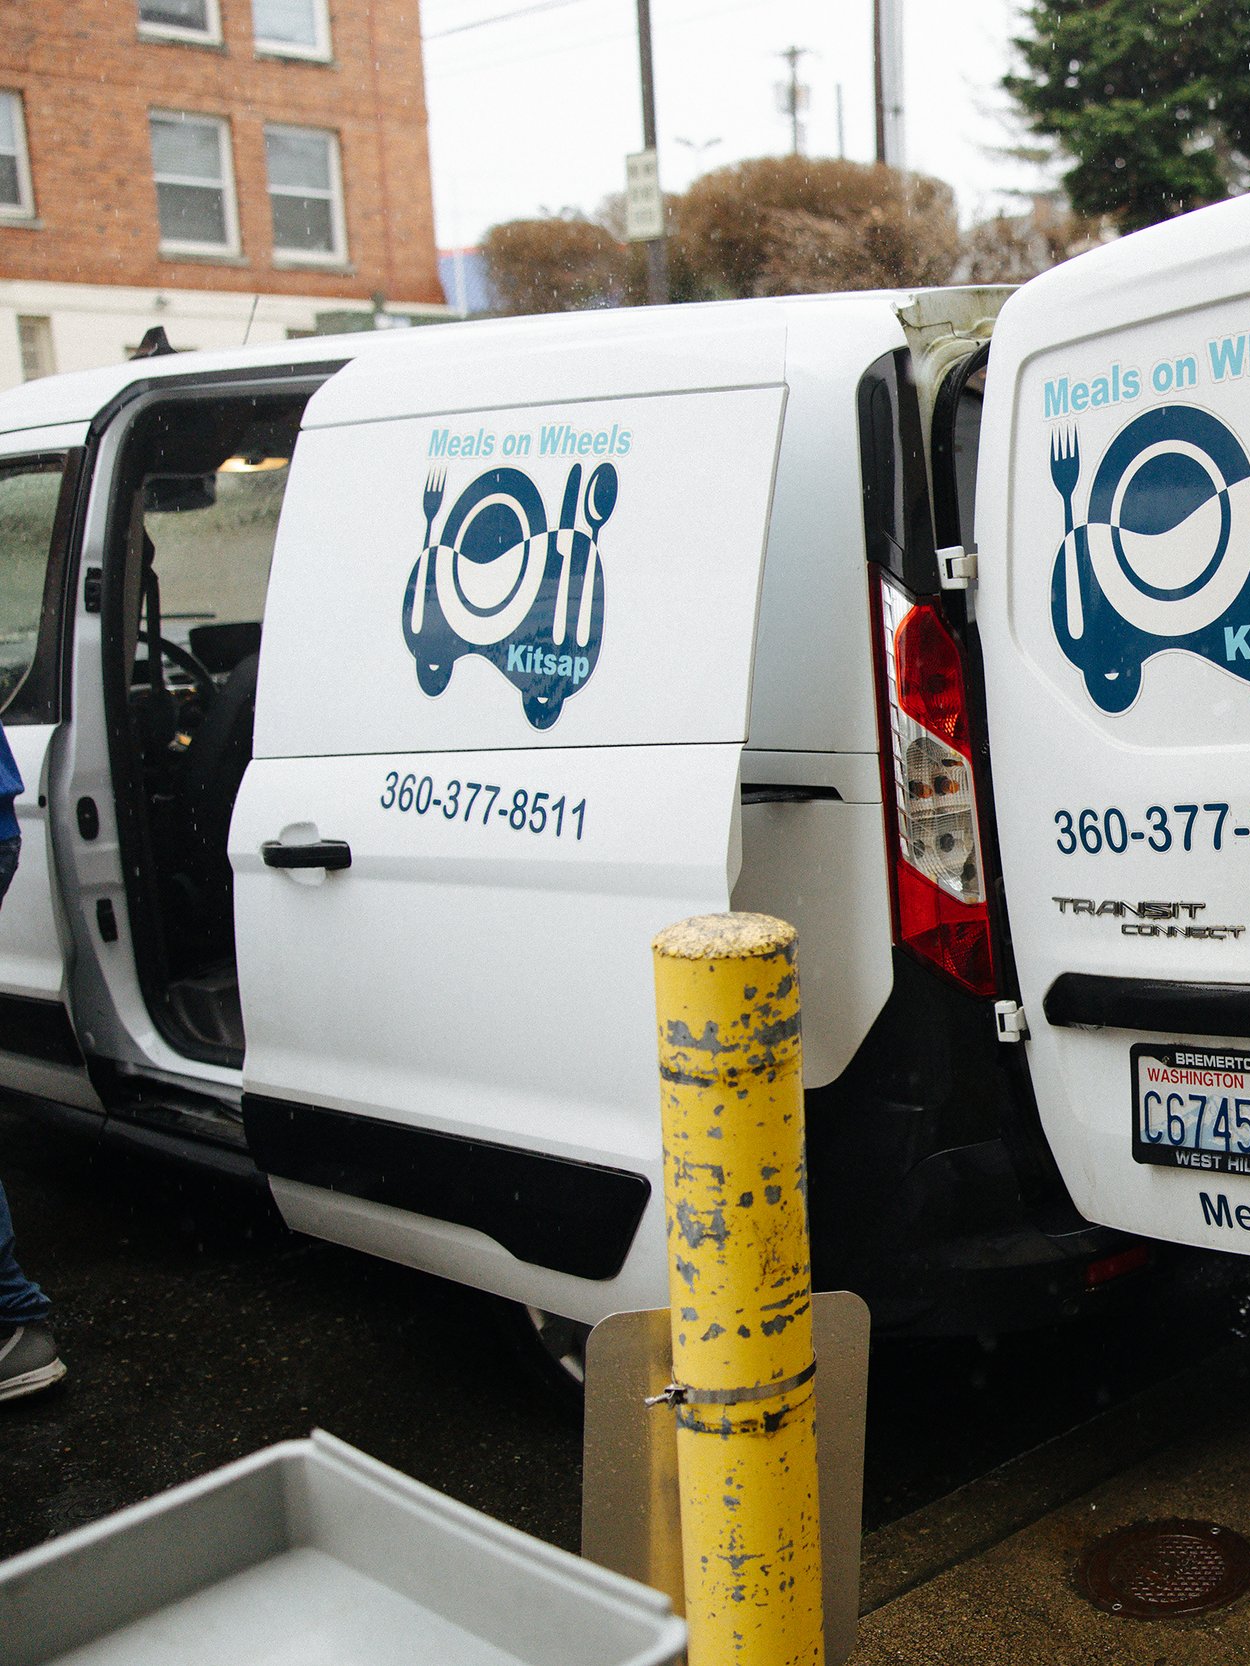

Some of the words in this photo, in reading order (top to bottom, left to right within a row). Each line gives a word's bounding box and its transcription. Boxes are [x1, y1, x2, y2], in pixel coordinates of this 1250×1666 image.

[1043, 364, 1140, 418] Meals
[1152, 355, 1197, 392] on
[428, 427, 494, 457] Meals
[502, 431, 531, 456] on
[539, 424, 631, 456] Wheels
[506, 643, 590, 684] Kitsap
[380, 770, 587, 841] 360-377-8511
[1051, 896, 1207, 921] TRANSIT
[1121, 923, 1246, 941] CONNECT
[1147, 1067, 1245, 1089] WASHINGTON
[1174, 1151, 1222, 1169] WEST
